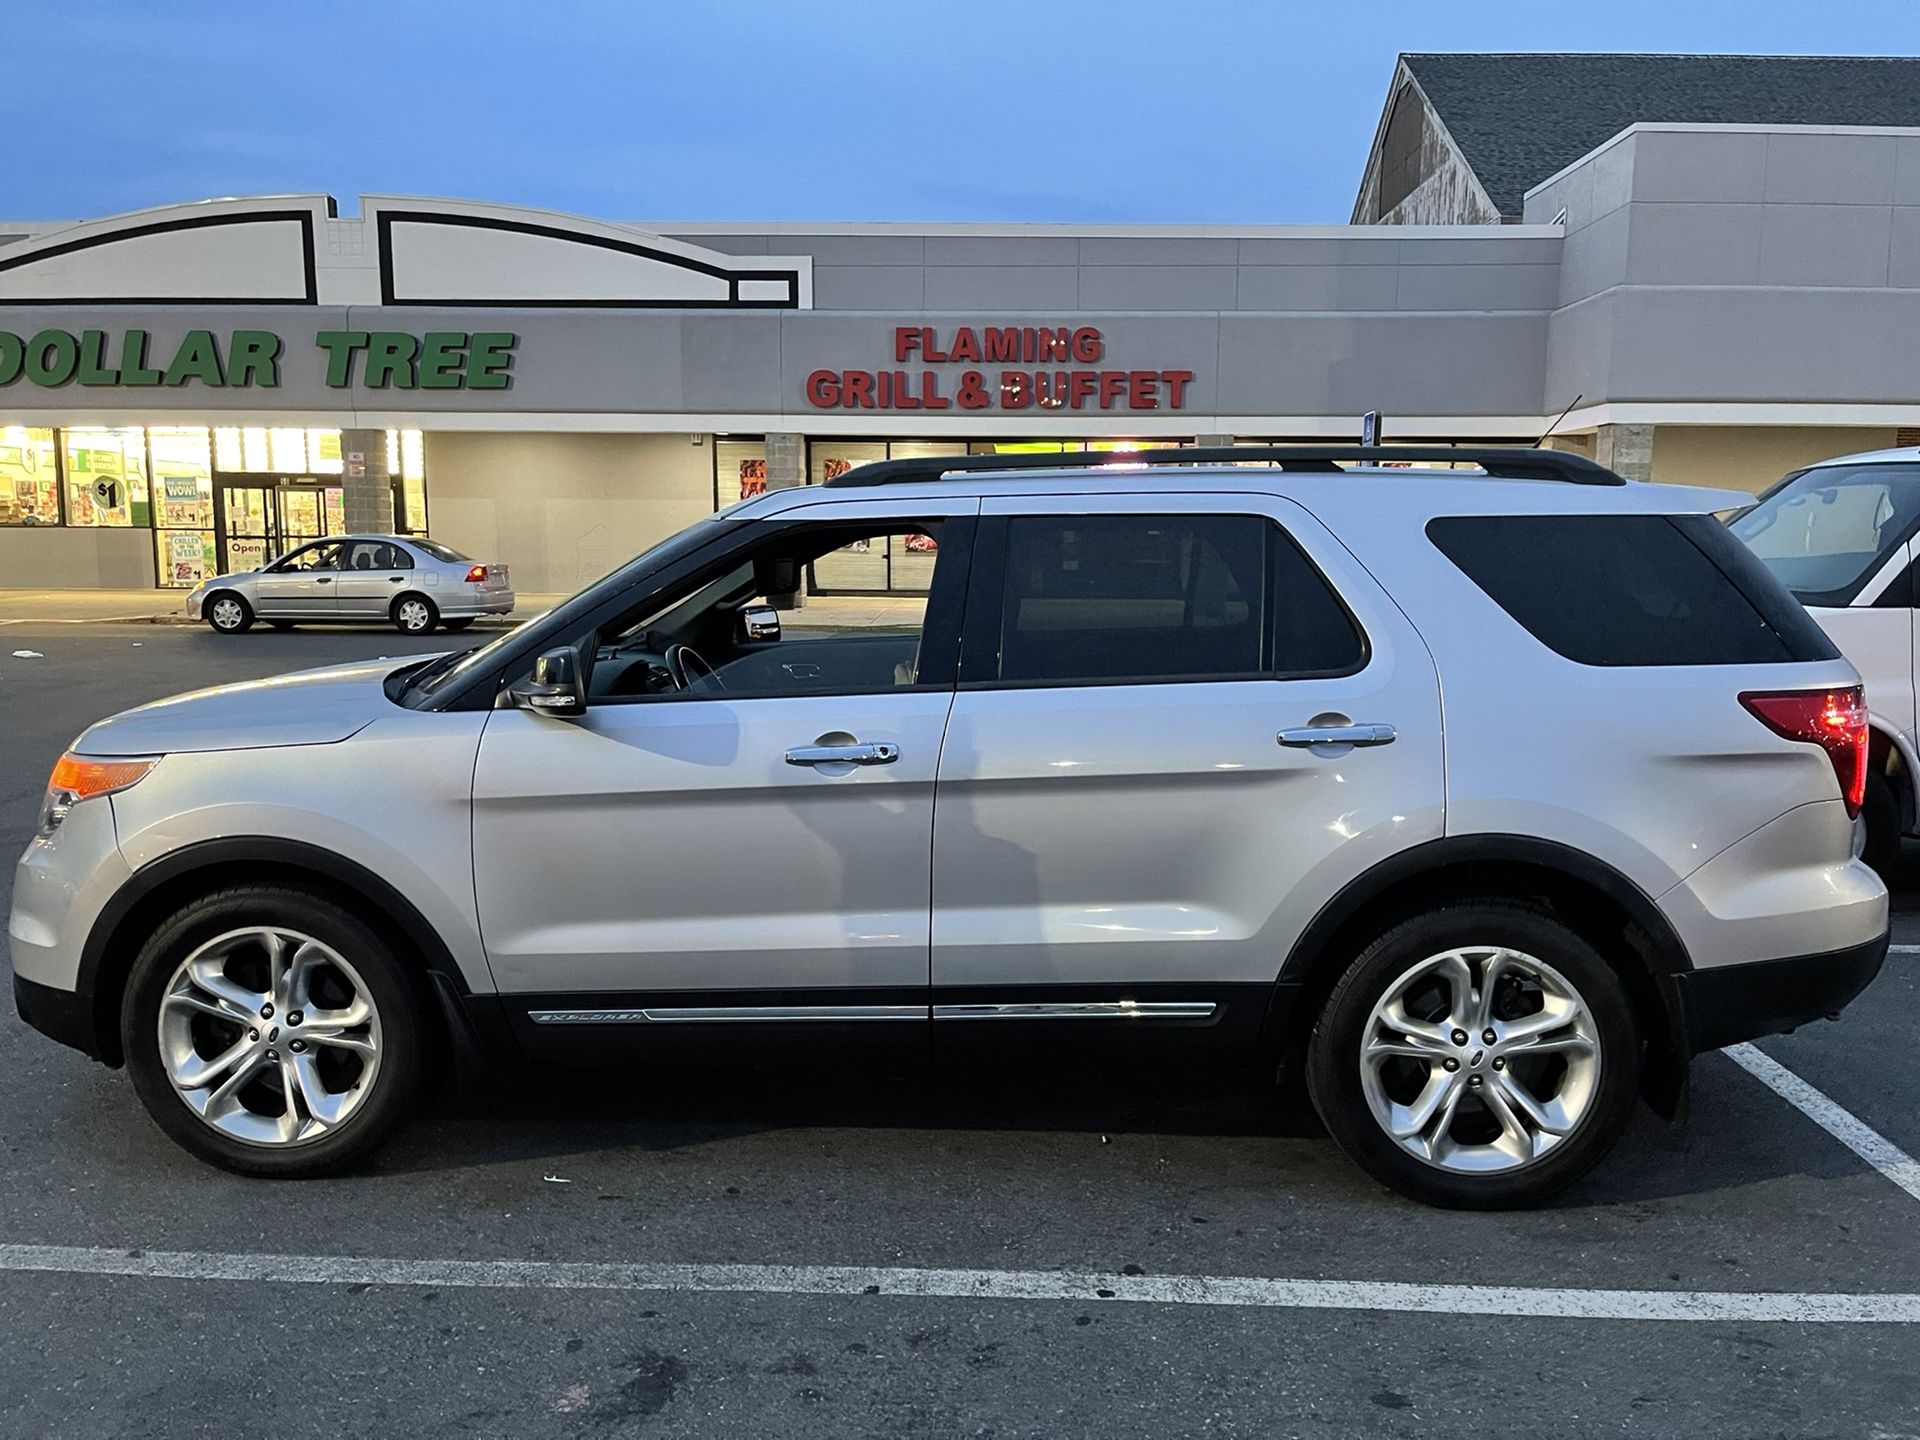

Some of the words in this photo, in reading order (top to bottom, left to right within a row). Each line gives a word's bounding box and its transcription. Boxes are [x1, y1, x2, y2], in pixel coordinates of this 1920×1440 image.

[895, 326, 1103, 363] FLAMING
[316, 330, 516, 389] TREE
[806, 370, 949, 409] GRILL
[957, 371, 990, 409] &
[1000, 370, 1193, 409] BUFFET
[97, 481, 117, 508] $1
[167, 485, 196, 496] WOW!
[175, 549, 200, 557] WEEK!
[231, 543, 261, 554] Open
[538, 1013, 642, 1021] EXPLORER
